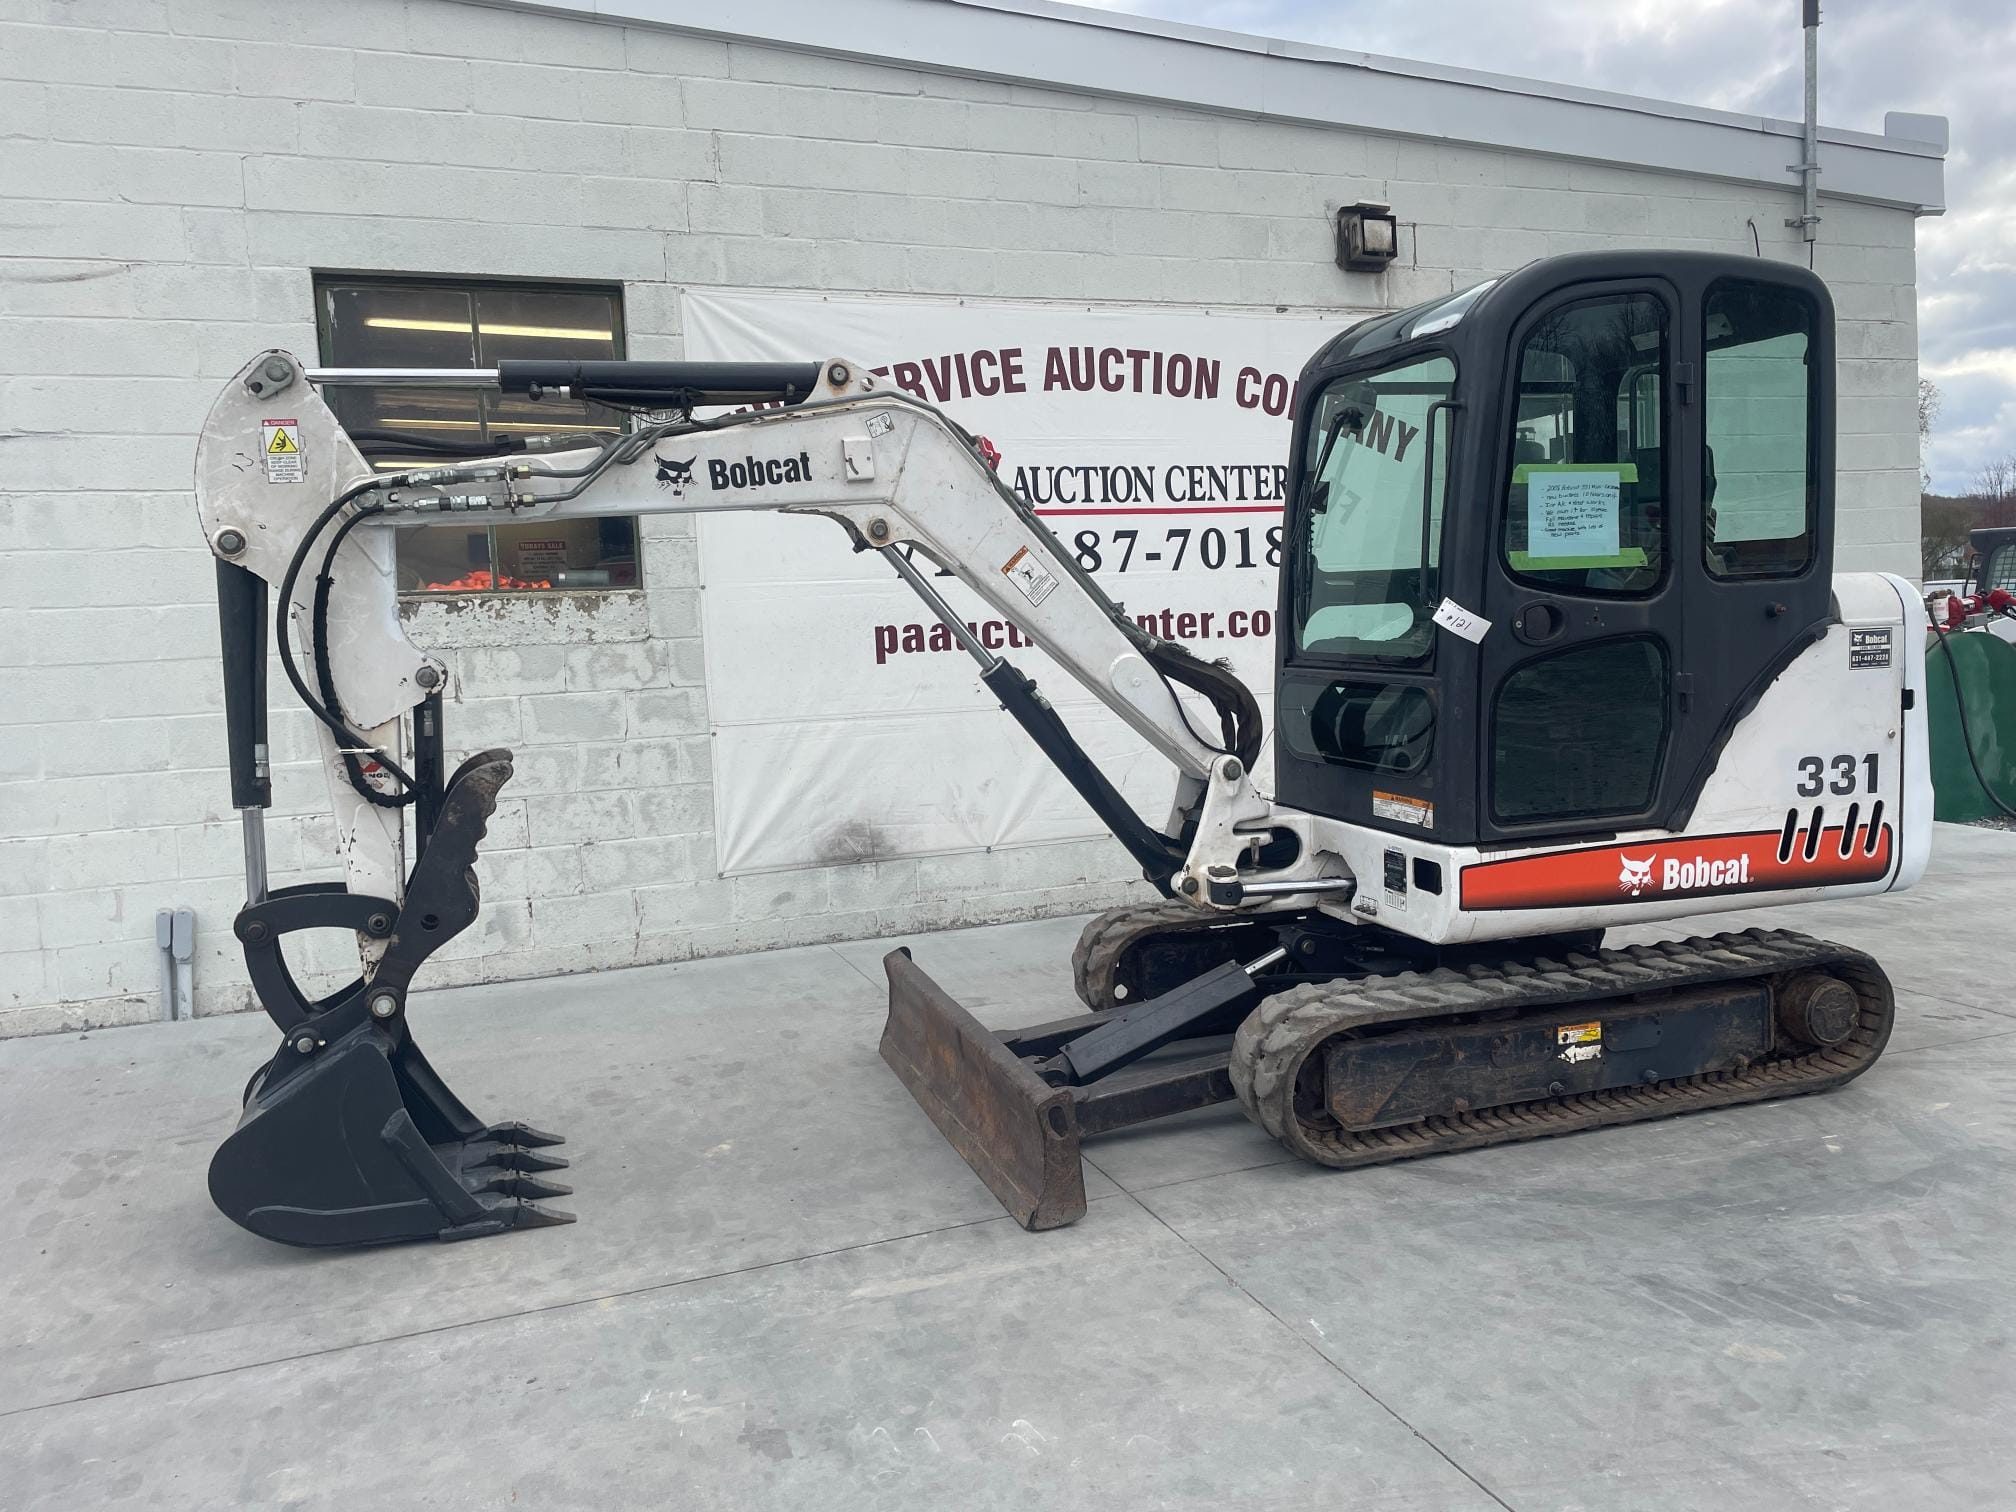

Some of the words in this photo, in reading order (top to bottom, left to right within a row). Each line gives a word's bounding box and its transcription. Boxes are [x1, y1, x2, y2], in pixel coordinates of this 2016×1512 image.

[868, 348, 1026, 403] RVICE
[1044, 346, 1220, 399] AUCTION
[707, 451, 812, 491] Bobcat
[1013, 465, 1157, 505] AUCTION
[1166, 463, 1288, 501] CENTER
[1050, 525, 1282, 574] 87-7018
[1866, 635, 1888, 644] Bobcat
[1797, 753, 1880, 798] 331
[1663, 854, 1750, 891] Bobcat
